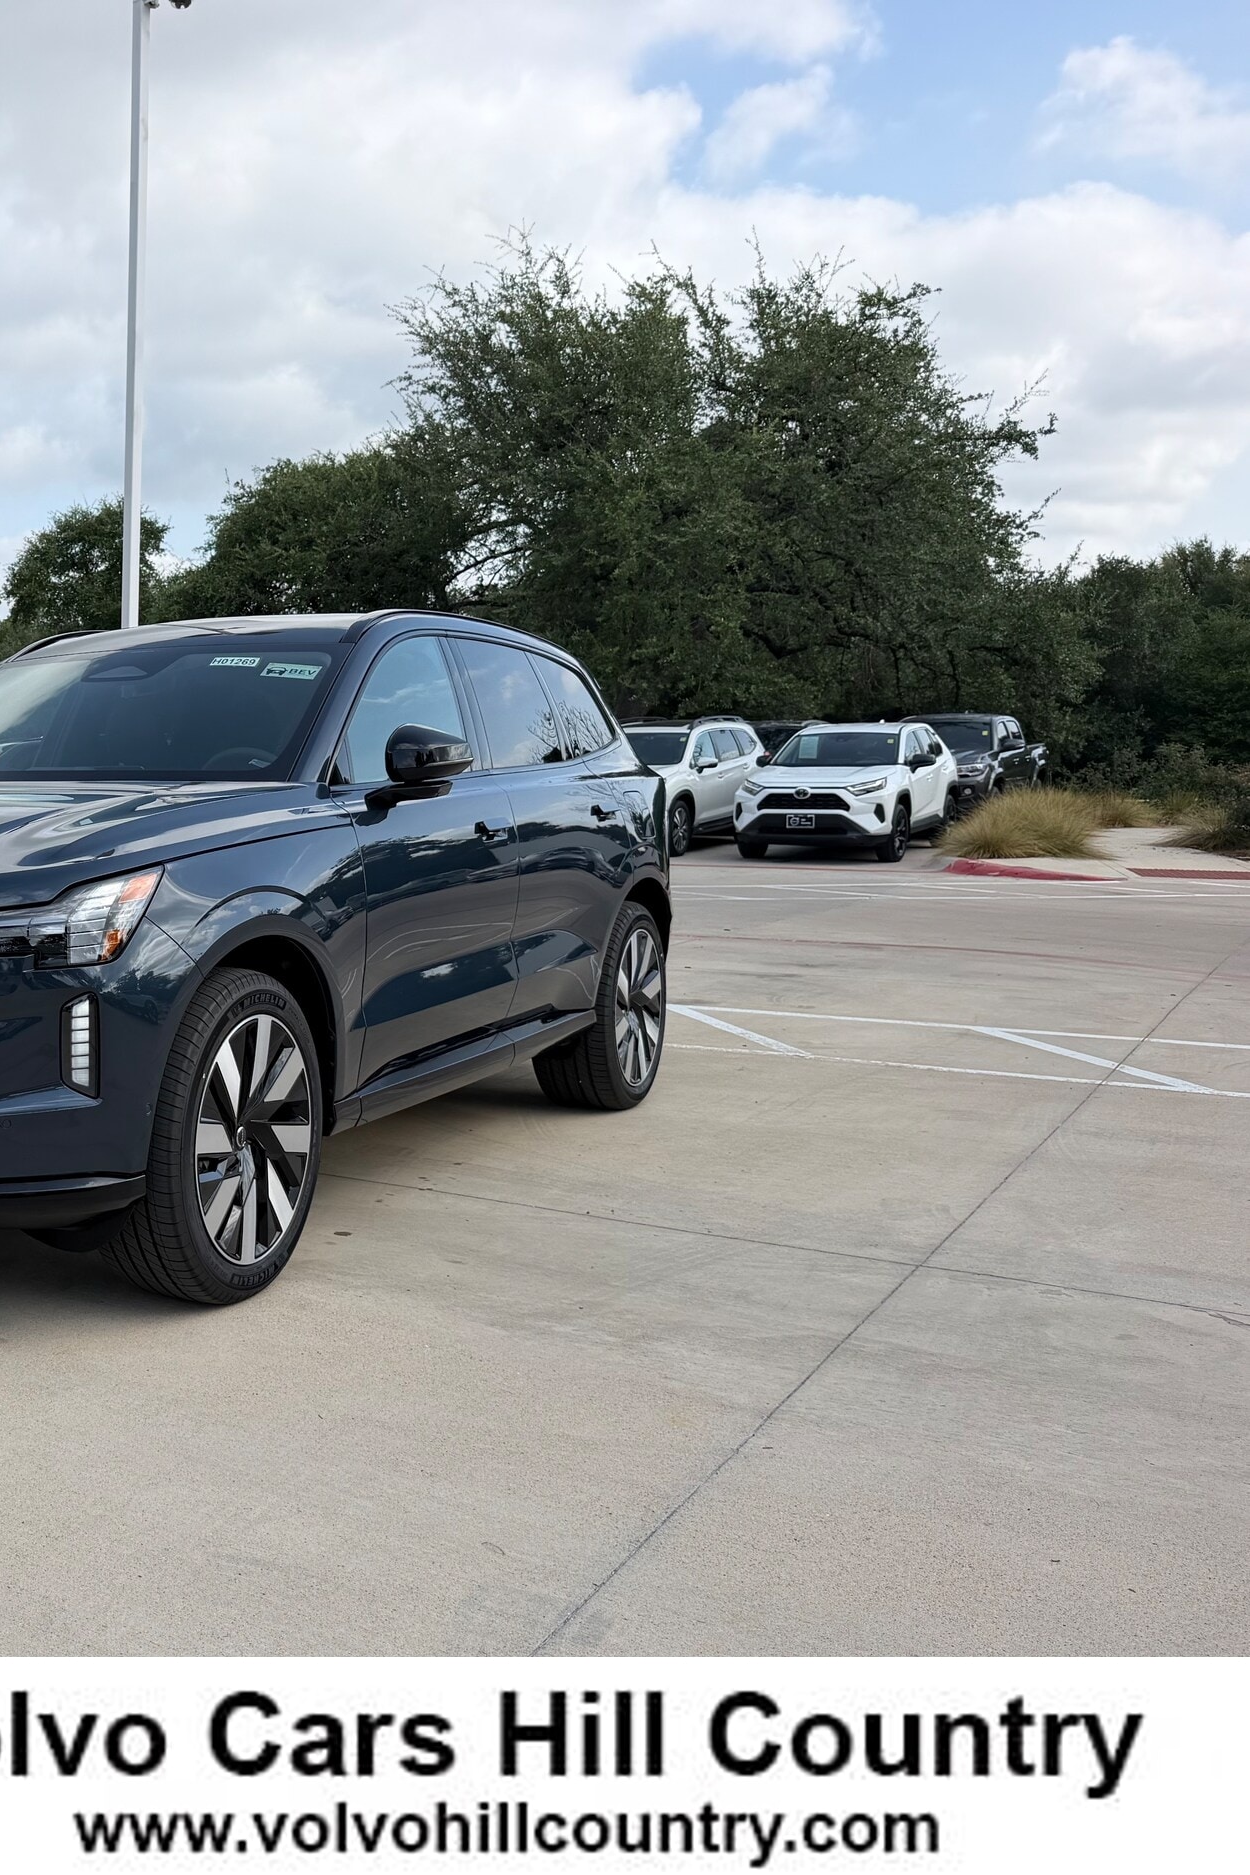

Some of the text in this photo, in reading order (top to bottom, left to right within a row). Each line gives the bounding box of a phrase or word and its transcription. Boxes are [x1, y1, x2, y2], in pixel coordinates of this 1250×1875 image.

[211, 658, 256, 666] H01269
[288, 668, 317, 676] BEV
[244, 993, 286, 1010] MICHELIN
